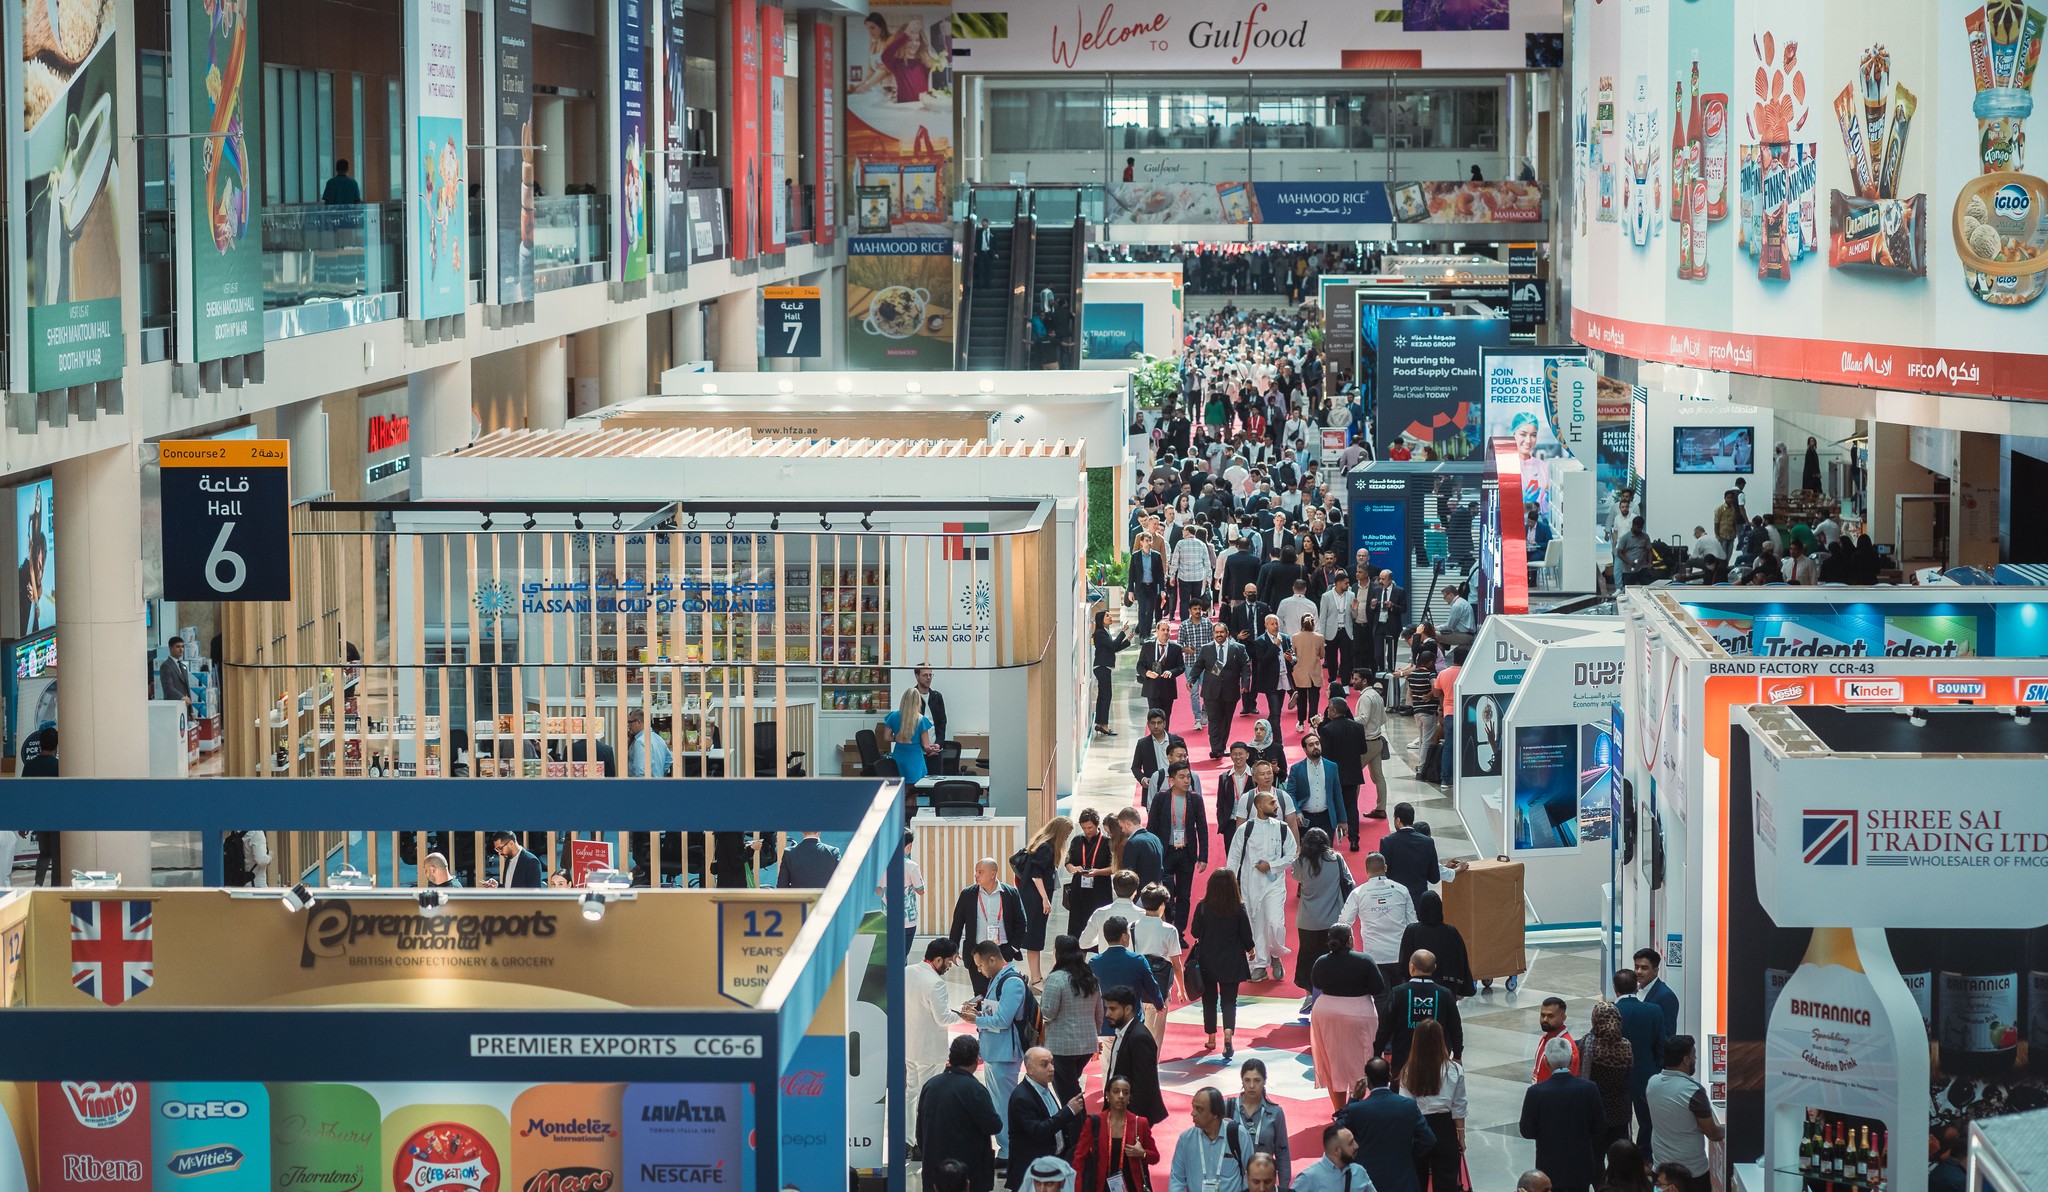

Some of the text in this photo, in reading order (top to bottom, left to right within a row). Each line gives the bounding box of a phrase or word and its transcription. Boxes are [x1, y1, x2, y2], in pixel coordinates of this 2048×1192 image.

[1052, 2, 1172, 68] Welcome
[1189, 2, 1308, 65] Gulfood
[1143, 157, 1180, 178] Gulfood
[1277, 192, 1366, 204] MAHMOOD RICE
[1295, 204, 1340, 216] محمود
[1494, 211, 1536, 220] MAHMOOD
[1845, 206, 1880, 238] Quanta
[853, 241, 944, 253] MAHMOOD RICE
[1848, 240, 1870, 257] ALMOND
[206, 297, 254, 318] SHEIKH MAKTOUM HALL
[780, 301, 804, 310] قاعة
[47, 321, 111, 346] SHEIKH MAKTOUM HALL
[215, 324, 230, 340] BOOTH
[783, 322, 802, 354] 7
[1393, 356, 1455, 366] Nurturing the
[1709, 345, 1726, 359] IFFCO
[58, 352, 78, 372] BOOTH
[1908, 363, 1935, 379] IFFCO
[1393, 368, 1477, 377] Food Supply Chain
[1491, 368, 1514, 376] JOIN
[1491, 377, 1528, 385] DUBAI'S
[757, 426, 818, 436] www.hfza.ae
[163, 448, 226, 459] Concourse 2
[251, 448, 284, 460] ردهة 2
[199, 474, 250, 493] قاعة
[208, 500, 242, 516] Hall
[205, 521, 247, 593] 6
[522, 575, 775, 598] مجموعة شركات حسني
[522, 600, 776, 613] HASSANI GROUP OF COMPANIES
[1763, 637, 1868, 657] Trident
[1709, 663, 1875, 674] BRAND FACTORY CCR-43
[1937, 683, 1982, 694] BOUNTY
[1866, 809, 2002, 829] SHREE SAI
[1866, 832, 2048, 852] TRADING LTD
[1908, 855, 2048, 867] WHOLESALER OF FMCG
[349, 911, 557, 944] premier exports
[743, 909, 783, 937] 12
[9, 932, 21, 965] 12
[397, 932, 480, 950] london ltd
[742, 946, 783, 957] YEAR'S
[349, 956, 555, 967] BRITISH CONFECTIONERY & GROCERY
[756, 964, 769, 974] IN
[733, 977, 770, 987] BUSIN
[1946, 978, 2010, 991] BRITANNICA
[1790, 998, 1871, 1027] BRITANNICA
[1811, 1028, 1851, 1046] Sparkling
[477, 1037, 756, 1056] PREMIER EXPORTS CC6-6
[1801, 1049, 1858, 1072] Celebration Drink
[67, 1084, 134, 1118] Vimto
[161, 1100, 249, 1120] OREO
[641, 1100, 726, 1122] LAVAZZA
[275, 1114, 374, 1147] Cadbury
[527, 1118, 612, 1138] Mondelēz
[553, 1134, 605, 1143] International
[781, 1132, 827, 1148] pepsi
[63, 1154, 142, 1182] Ribena
[178, 1150, 233, 1172] McVitie's
[279, 1165, 365, 1189] Thorntons
[525, 1168, 614, 1192] Mars
